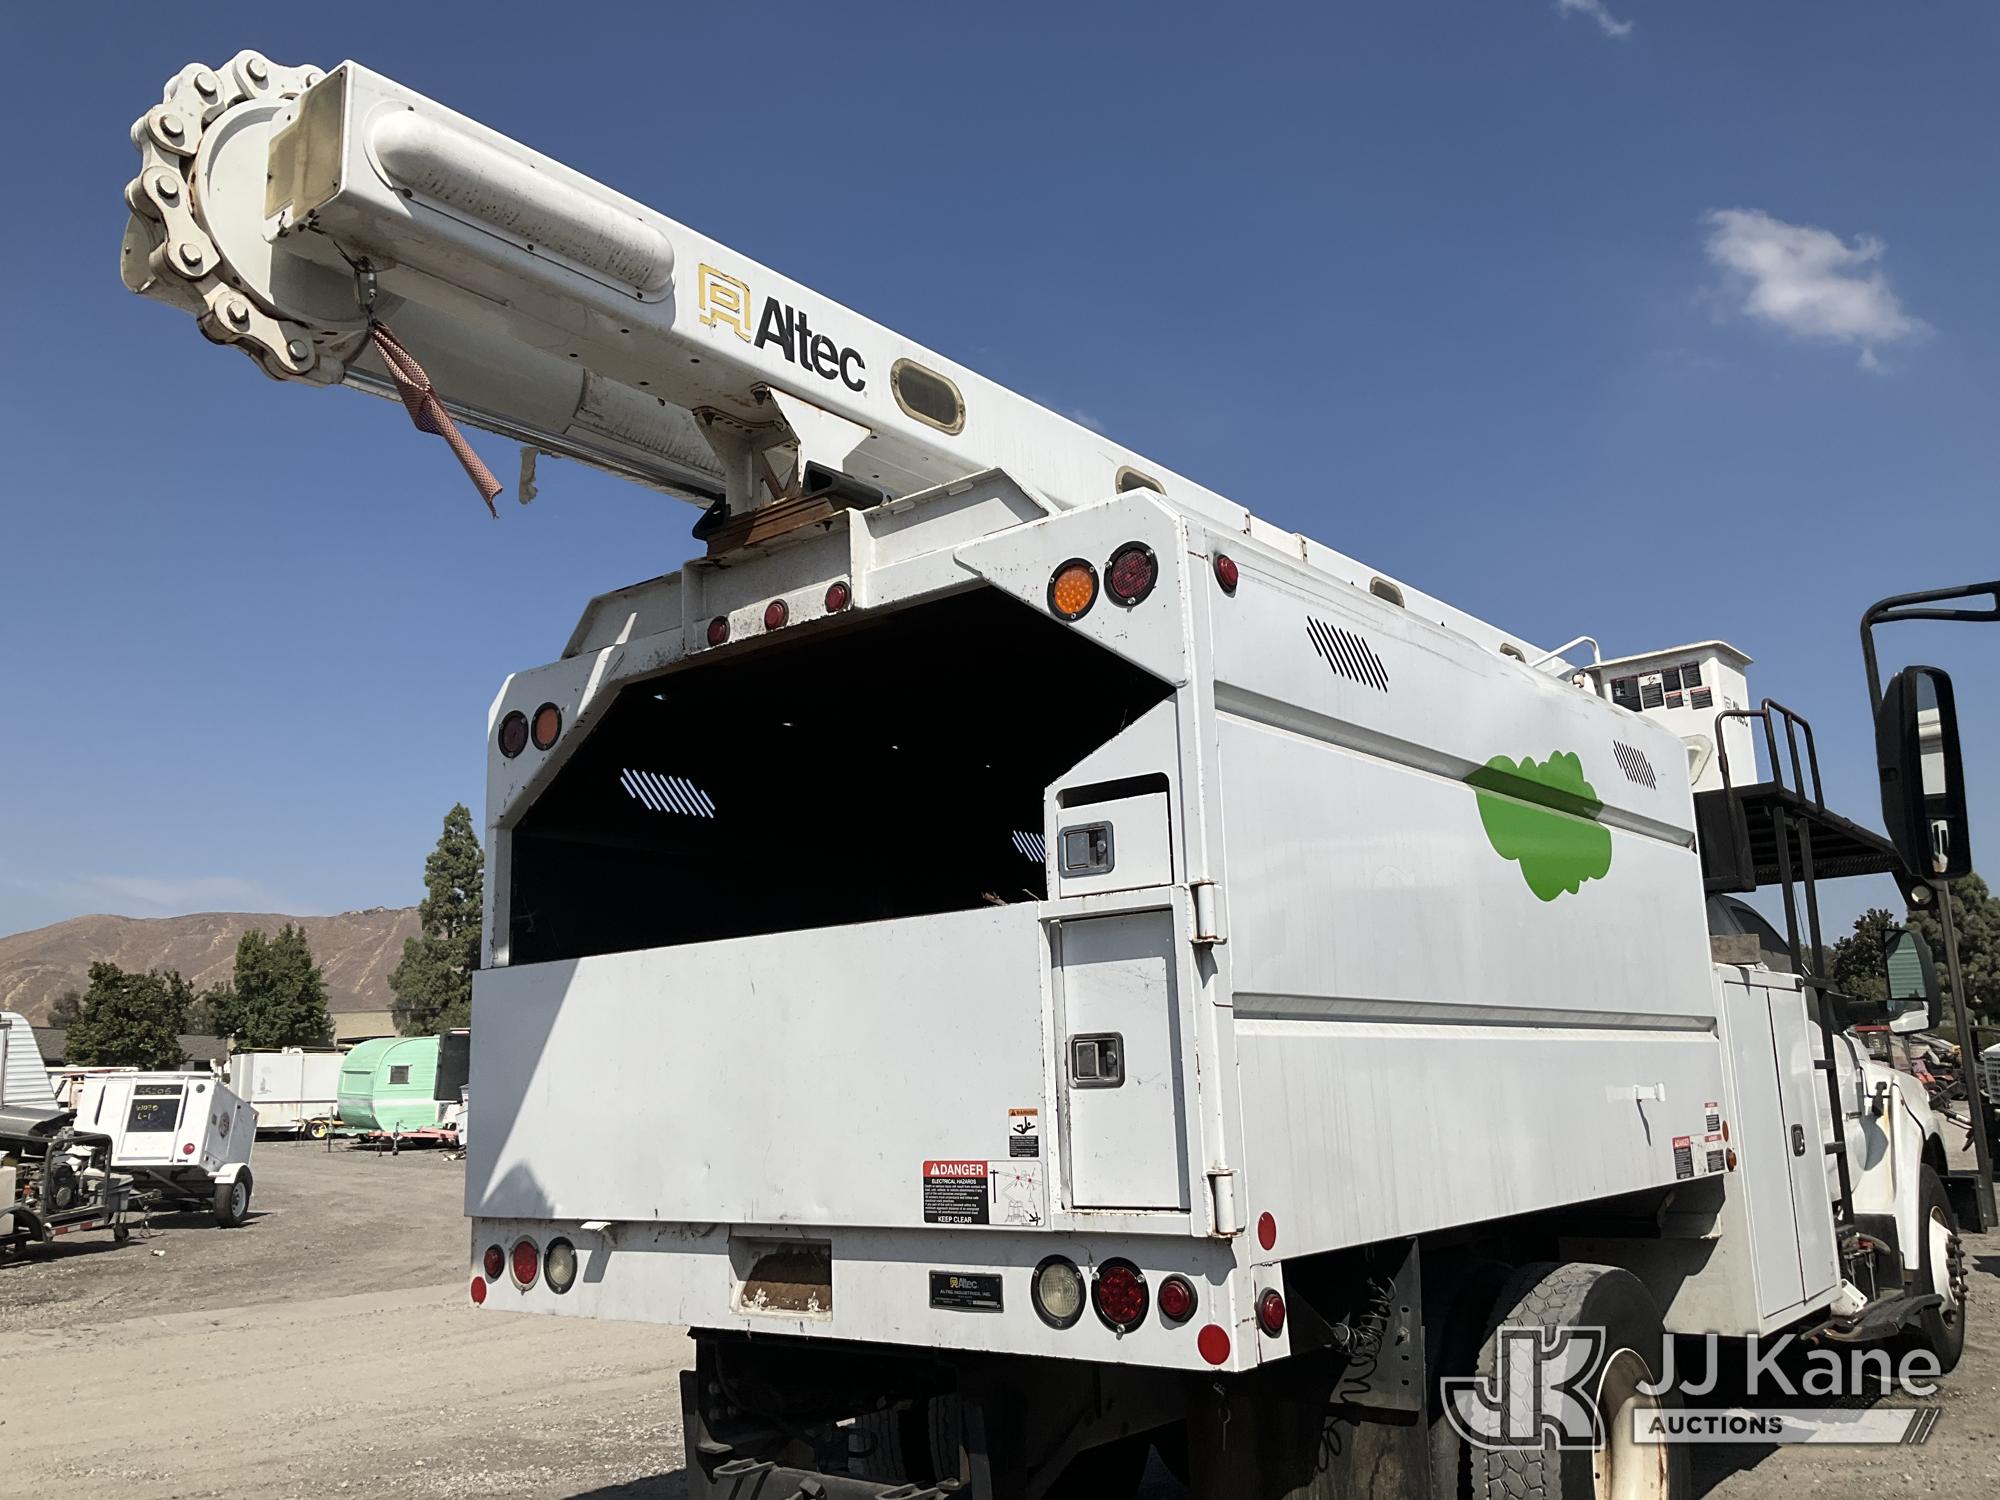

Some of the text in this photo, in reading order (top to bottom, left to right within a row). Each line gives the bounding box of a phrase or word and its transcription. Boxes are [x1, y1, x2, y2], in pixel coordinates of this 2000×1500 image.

[754, 296, 866, 392] Altec
[940, 1164, 984, 1176] DANGER
[937, 1215, 972, 1224] KEEP CLEAR
[958, 1277, 978, 1289] Altec
